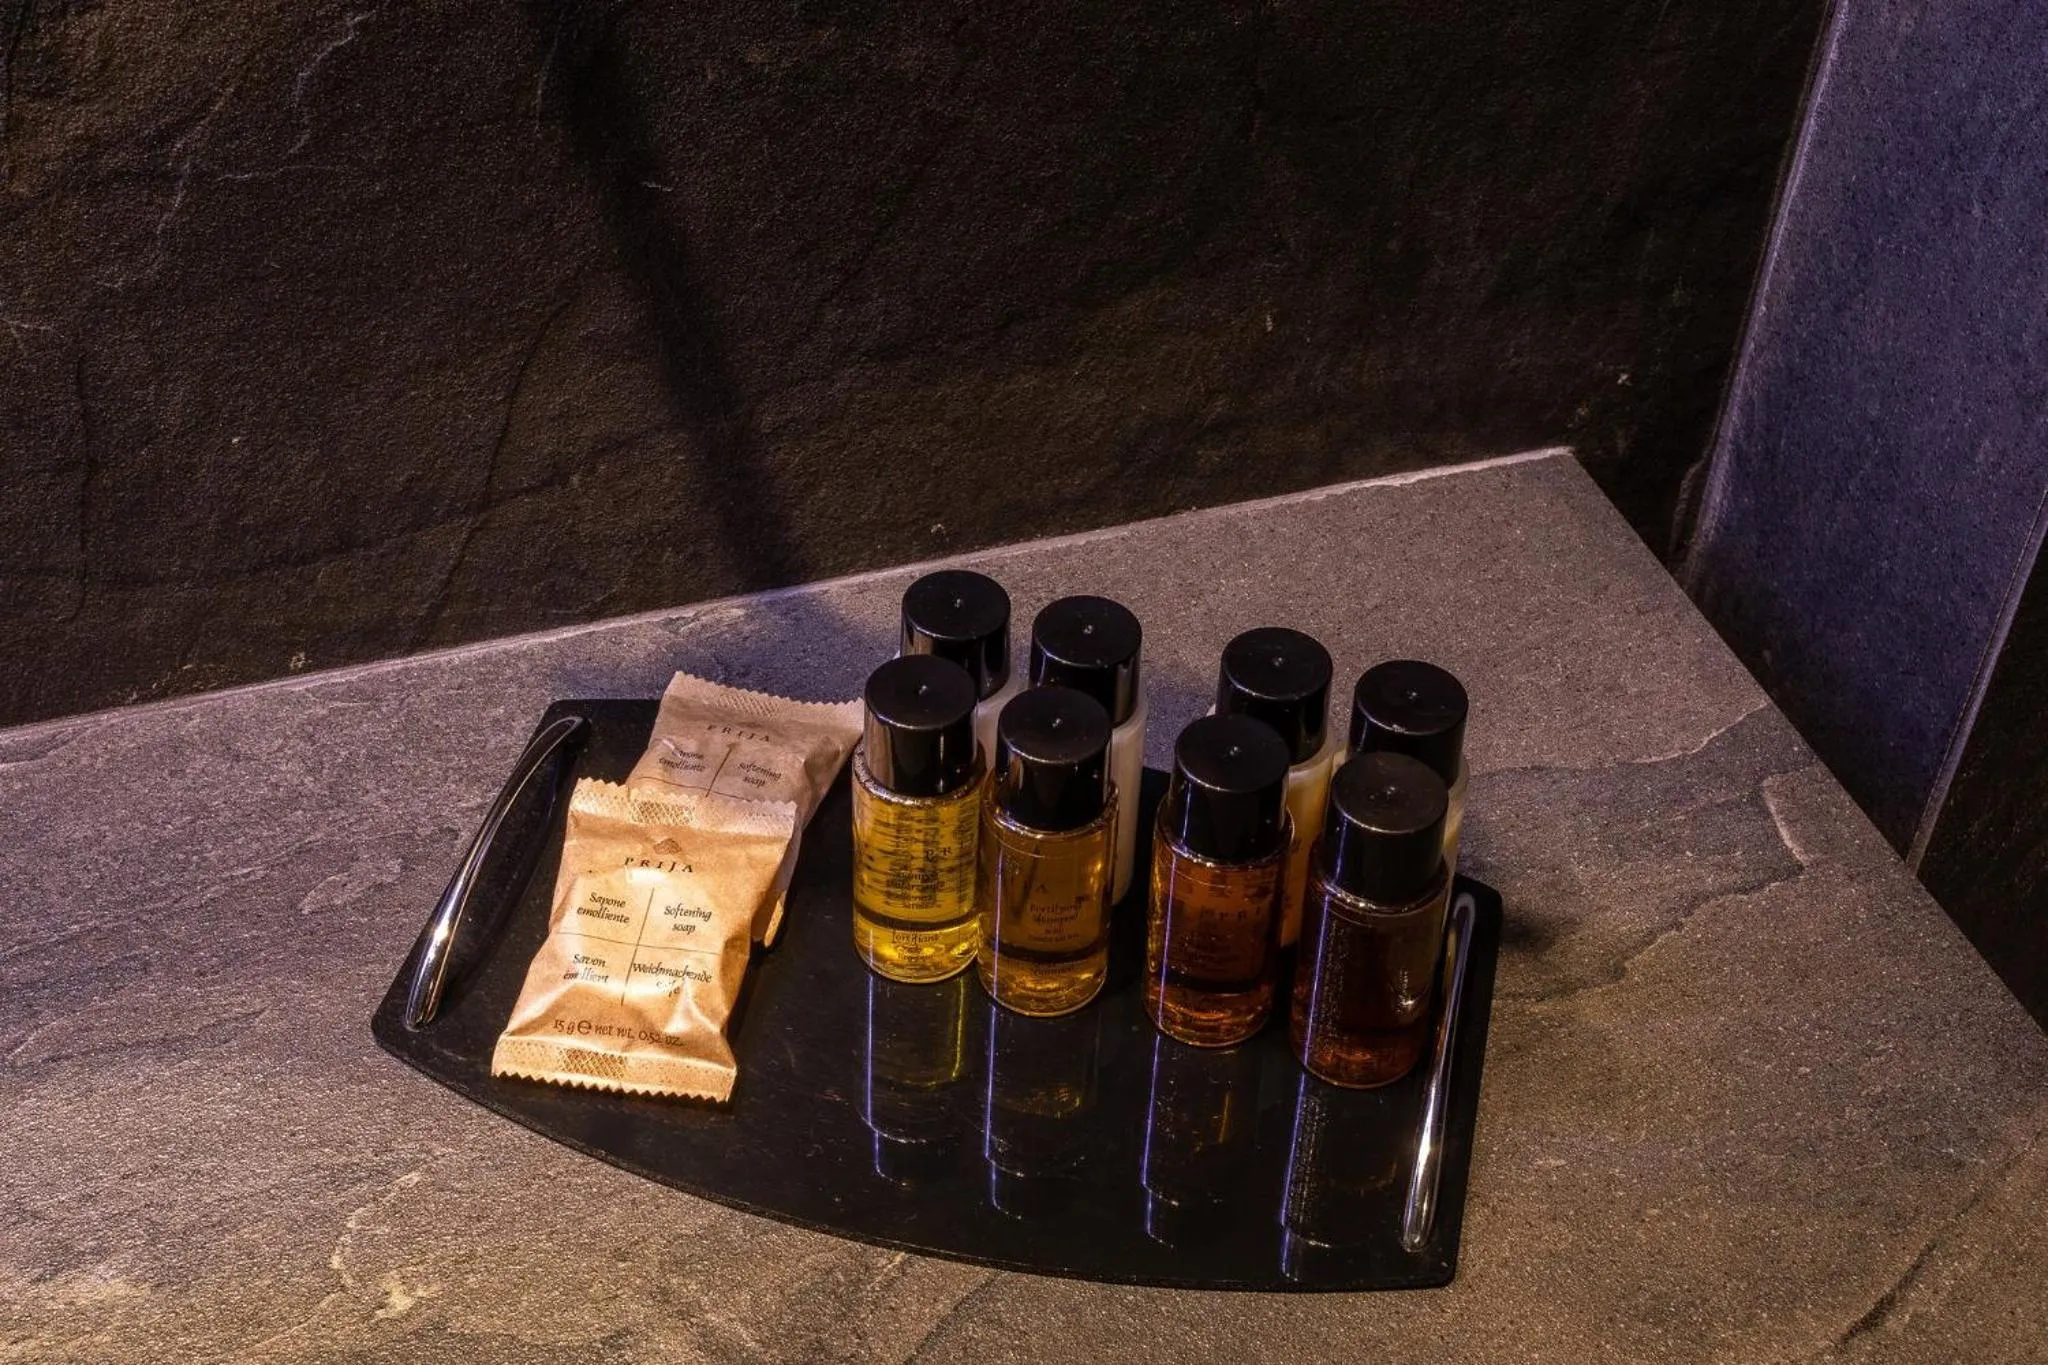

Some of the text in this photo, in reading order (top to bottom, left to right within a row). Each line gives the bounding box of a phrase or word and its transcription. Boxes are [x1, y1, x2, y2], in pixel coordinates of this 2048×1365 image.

[707, 724, 770, 742] PRIJA
[624, 857, 694, 873] PRIJA
[589, 892, 627, 909] Sapone
[576, 906, 631, 924] emolliente
[663, 903, 713, 922] Softening
[671, 923, 696, 935] soap
[572, 953, 606, 968] Savon
[553, 1019, 565, 1032] 15
